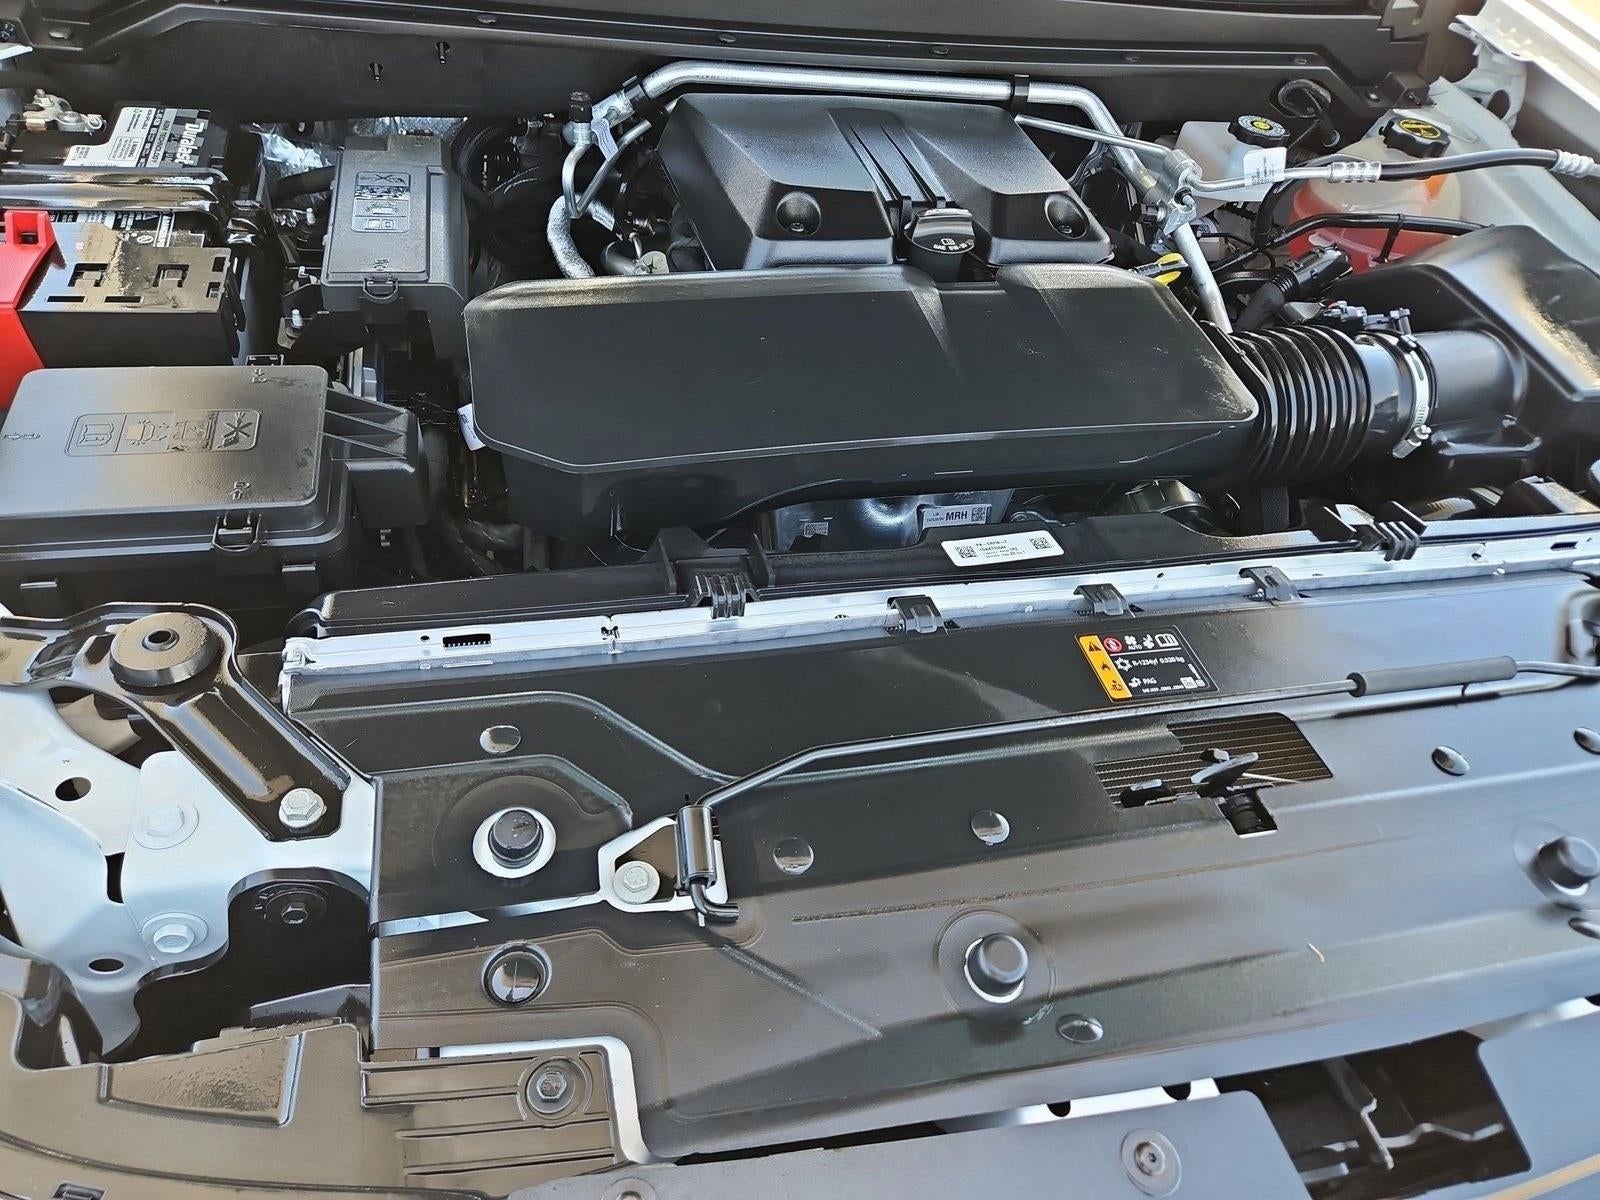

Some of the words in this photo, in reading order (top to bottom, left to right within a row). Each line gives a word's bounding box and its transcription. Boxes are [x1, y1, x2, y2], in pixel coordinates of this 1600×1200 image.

[163, 120, 171, 132] AGM
[152, 132, 167, 163] TECHNOLOGY
[174, 122, 205, 165] Duralast
[945, 510, 968, 521] MRH
[1131, 657, 1159, 667] R-1234yf
[1142, 677, 1158, 685] PAG
